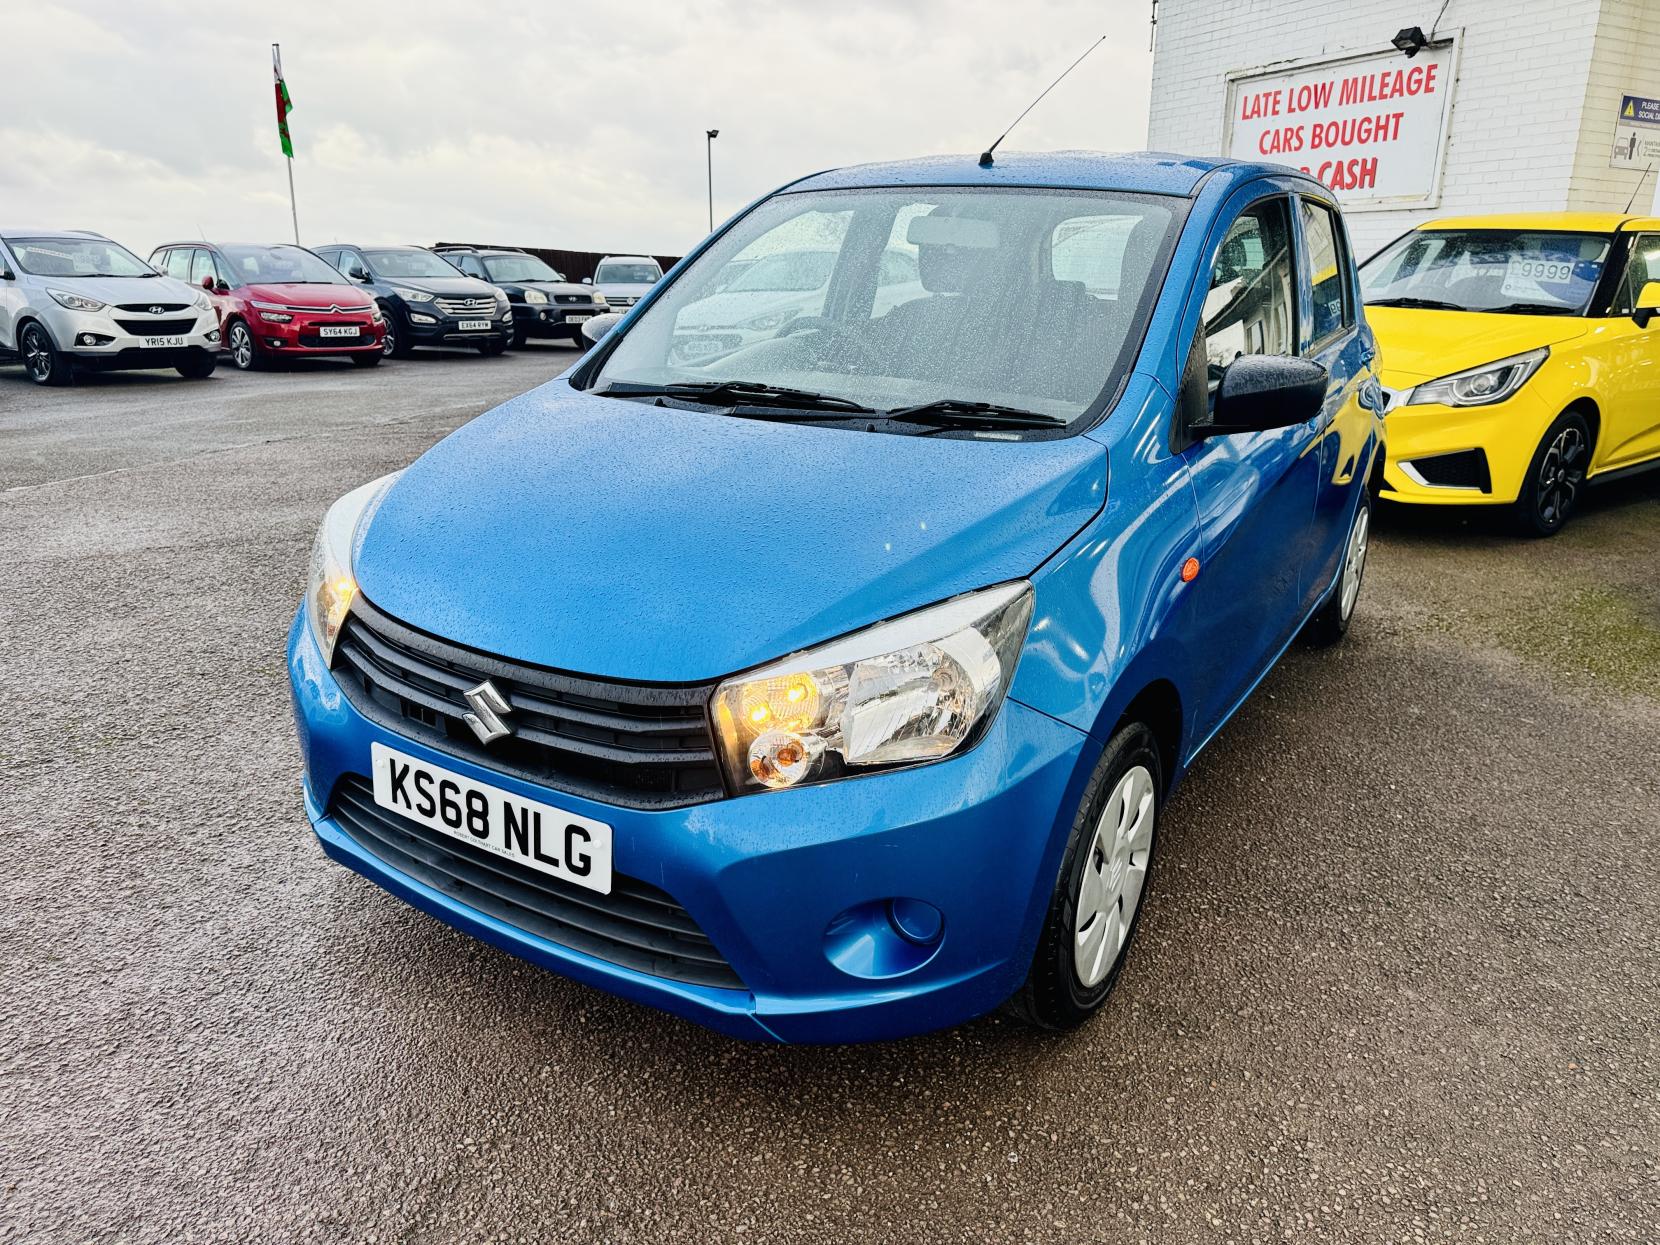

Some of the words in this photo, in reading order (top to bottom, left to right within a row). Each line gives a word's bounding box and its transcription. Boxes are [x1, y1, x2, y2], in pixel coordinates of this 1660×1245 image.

[1241, 90, 1282, 121] LATE
[1287, 81, 1334, 114] LOW
[1338, 63, 1438, 106] MILEAGE
[1638, 110, 1654, 120] SOCIAL
[1641, 101, 1660, 111] PLEASE
[1258, 125, 1304, 155] CARS
[1311, 112, 1405, 150] BOUGHT
[1317, 157, 1378, 191] CASH
[145, 337, 165, 346] YR15
[166, 336, 184, 346] KJU
[323, 328, 342, 336] SY64
[343, 328, 358, 336] KGJ
[389, 757, 490, 840] KS68
[503, 800, 592, 877] NLG
